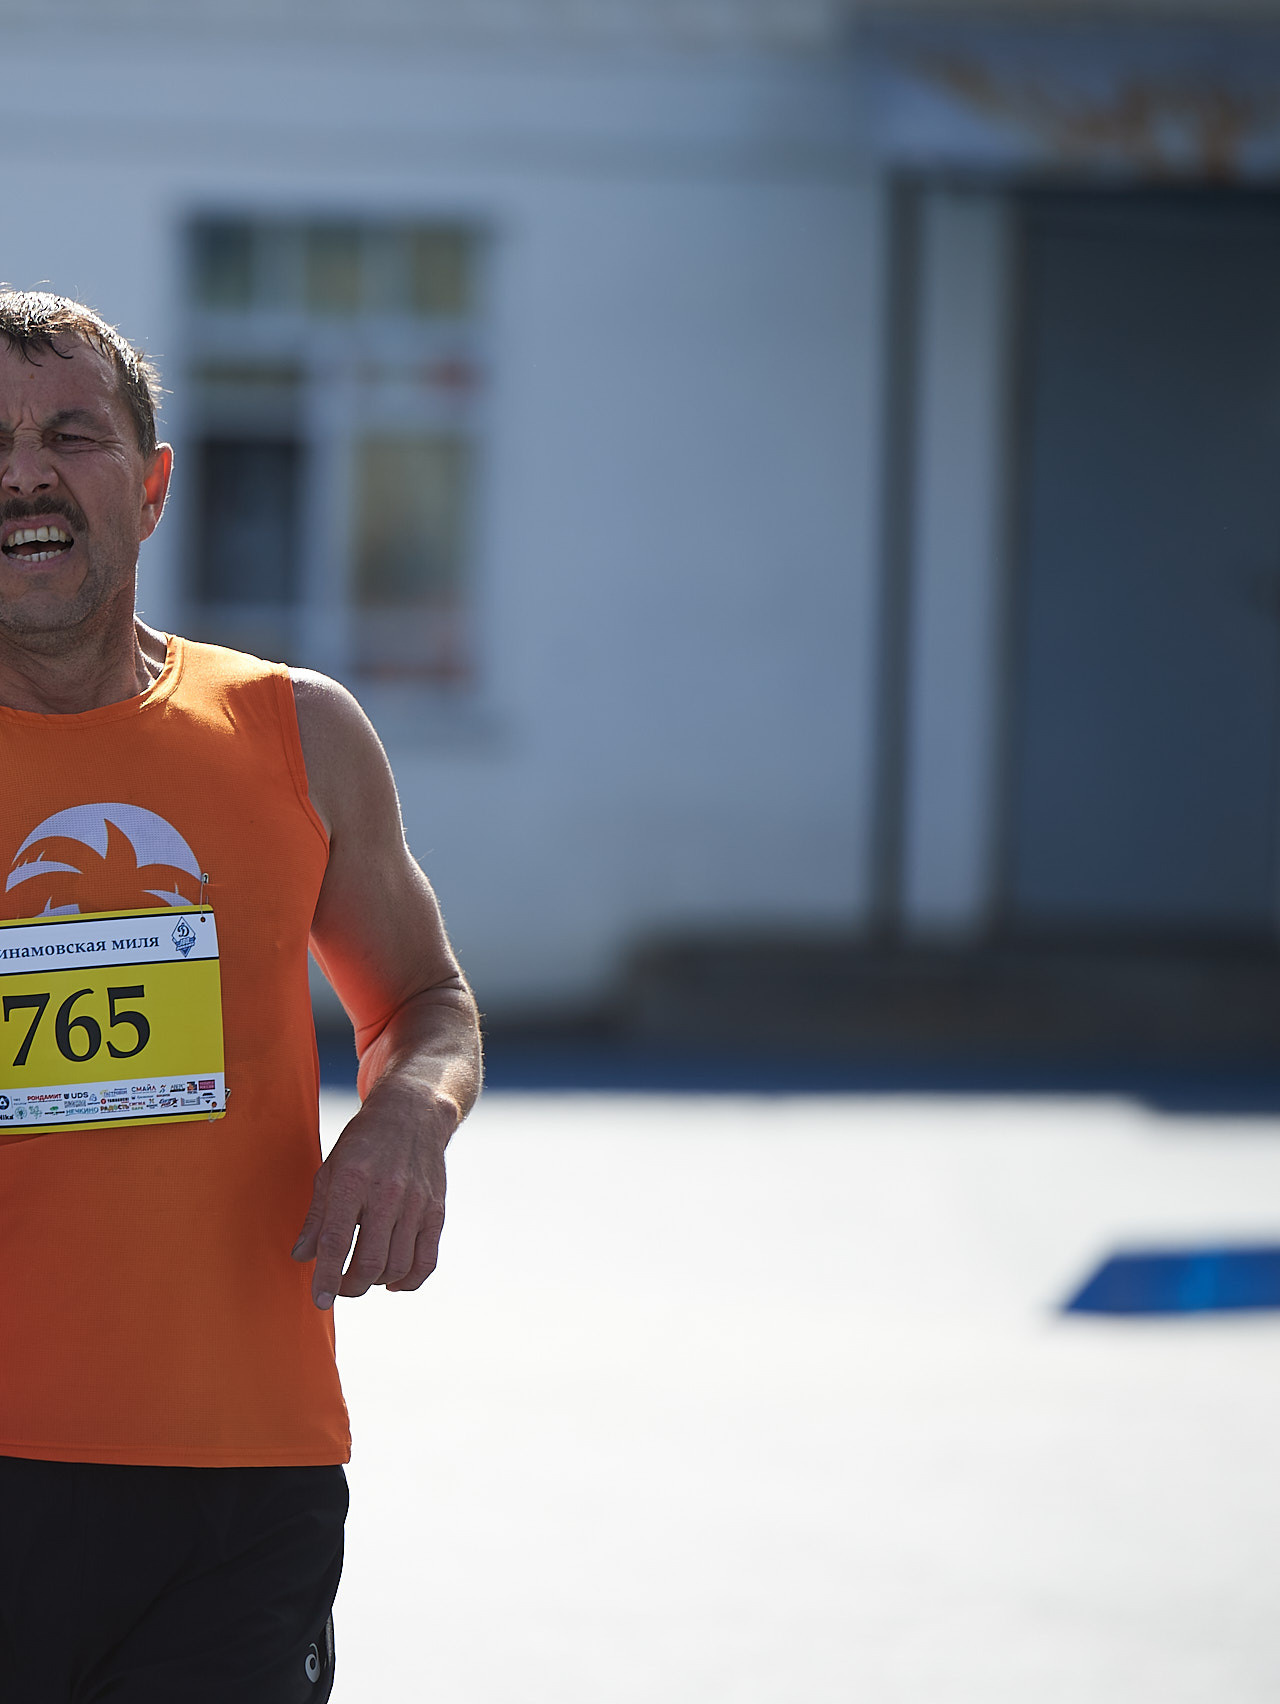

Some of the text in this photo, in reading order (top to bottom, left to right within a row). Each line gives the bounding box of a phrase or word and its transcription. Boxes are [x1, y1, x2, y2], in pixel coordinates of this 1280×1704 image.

[111, 936, 160, 952] миля
[2, 984, 151, 1067] 765
[27, 1093, 62, 1102] РОНДАМИТ
[70, 1091, 89, 1099] UDS
[65, 1106, 100, 1115] НЕЧКИНО
